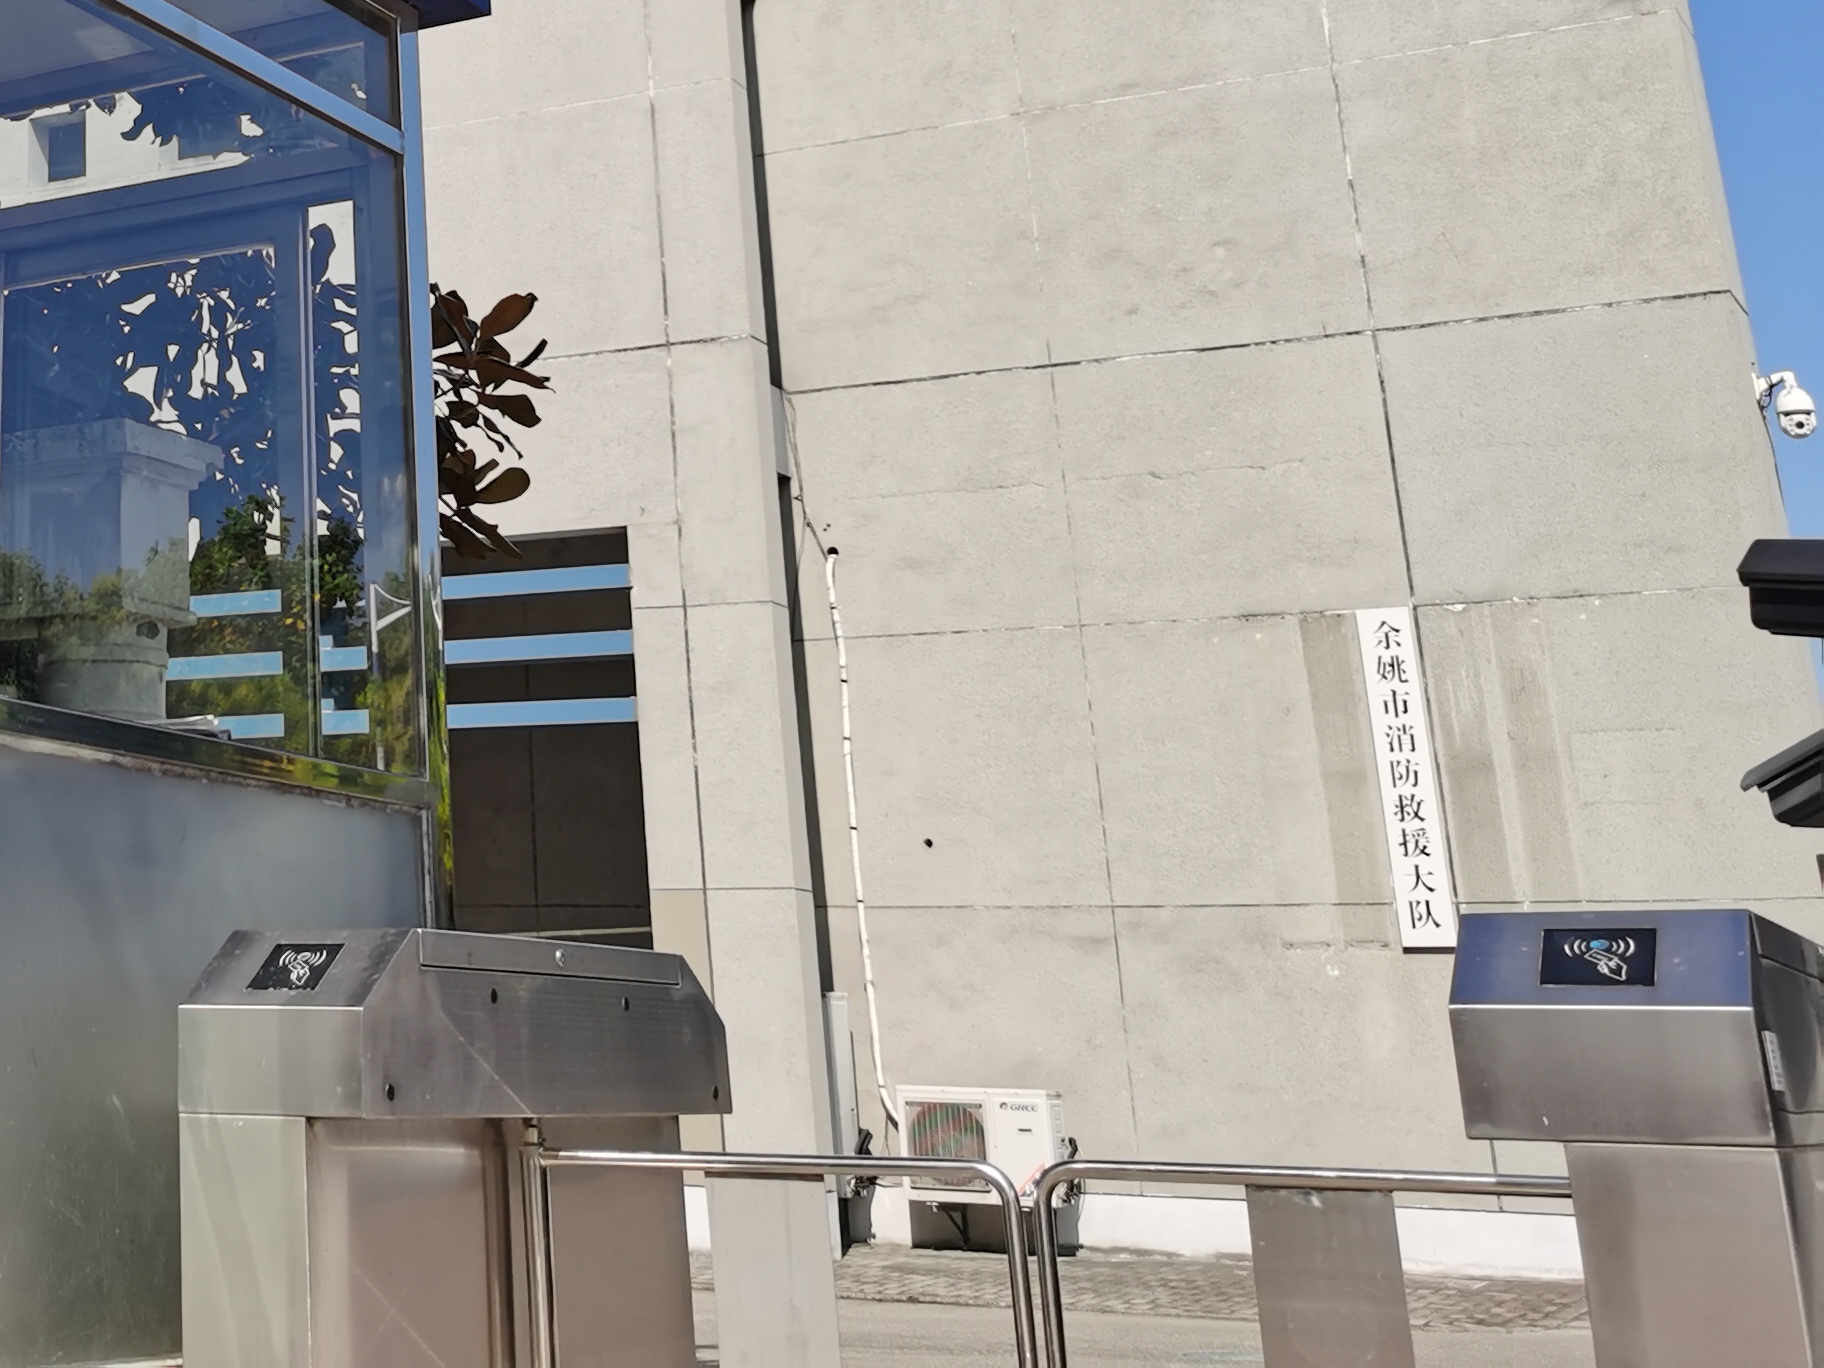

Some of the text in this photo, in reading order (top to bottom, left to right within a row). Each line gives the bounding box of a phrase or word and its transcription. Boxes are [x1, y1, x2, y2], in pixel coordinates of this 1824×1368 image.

[1372, 619, 1443, 930] 余姚市消防救援大队
